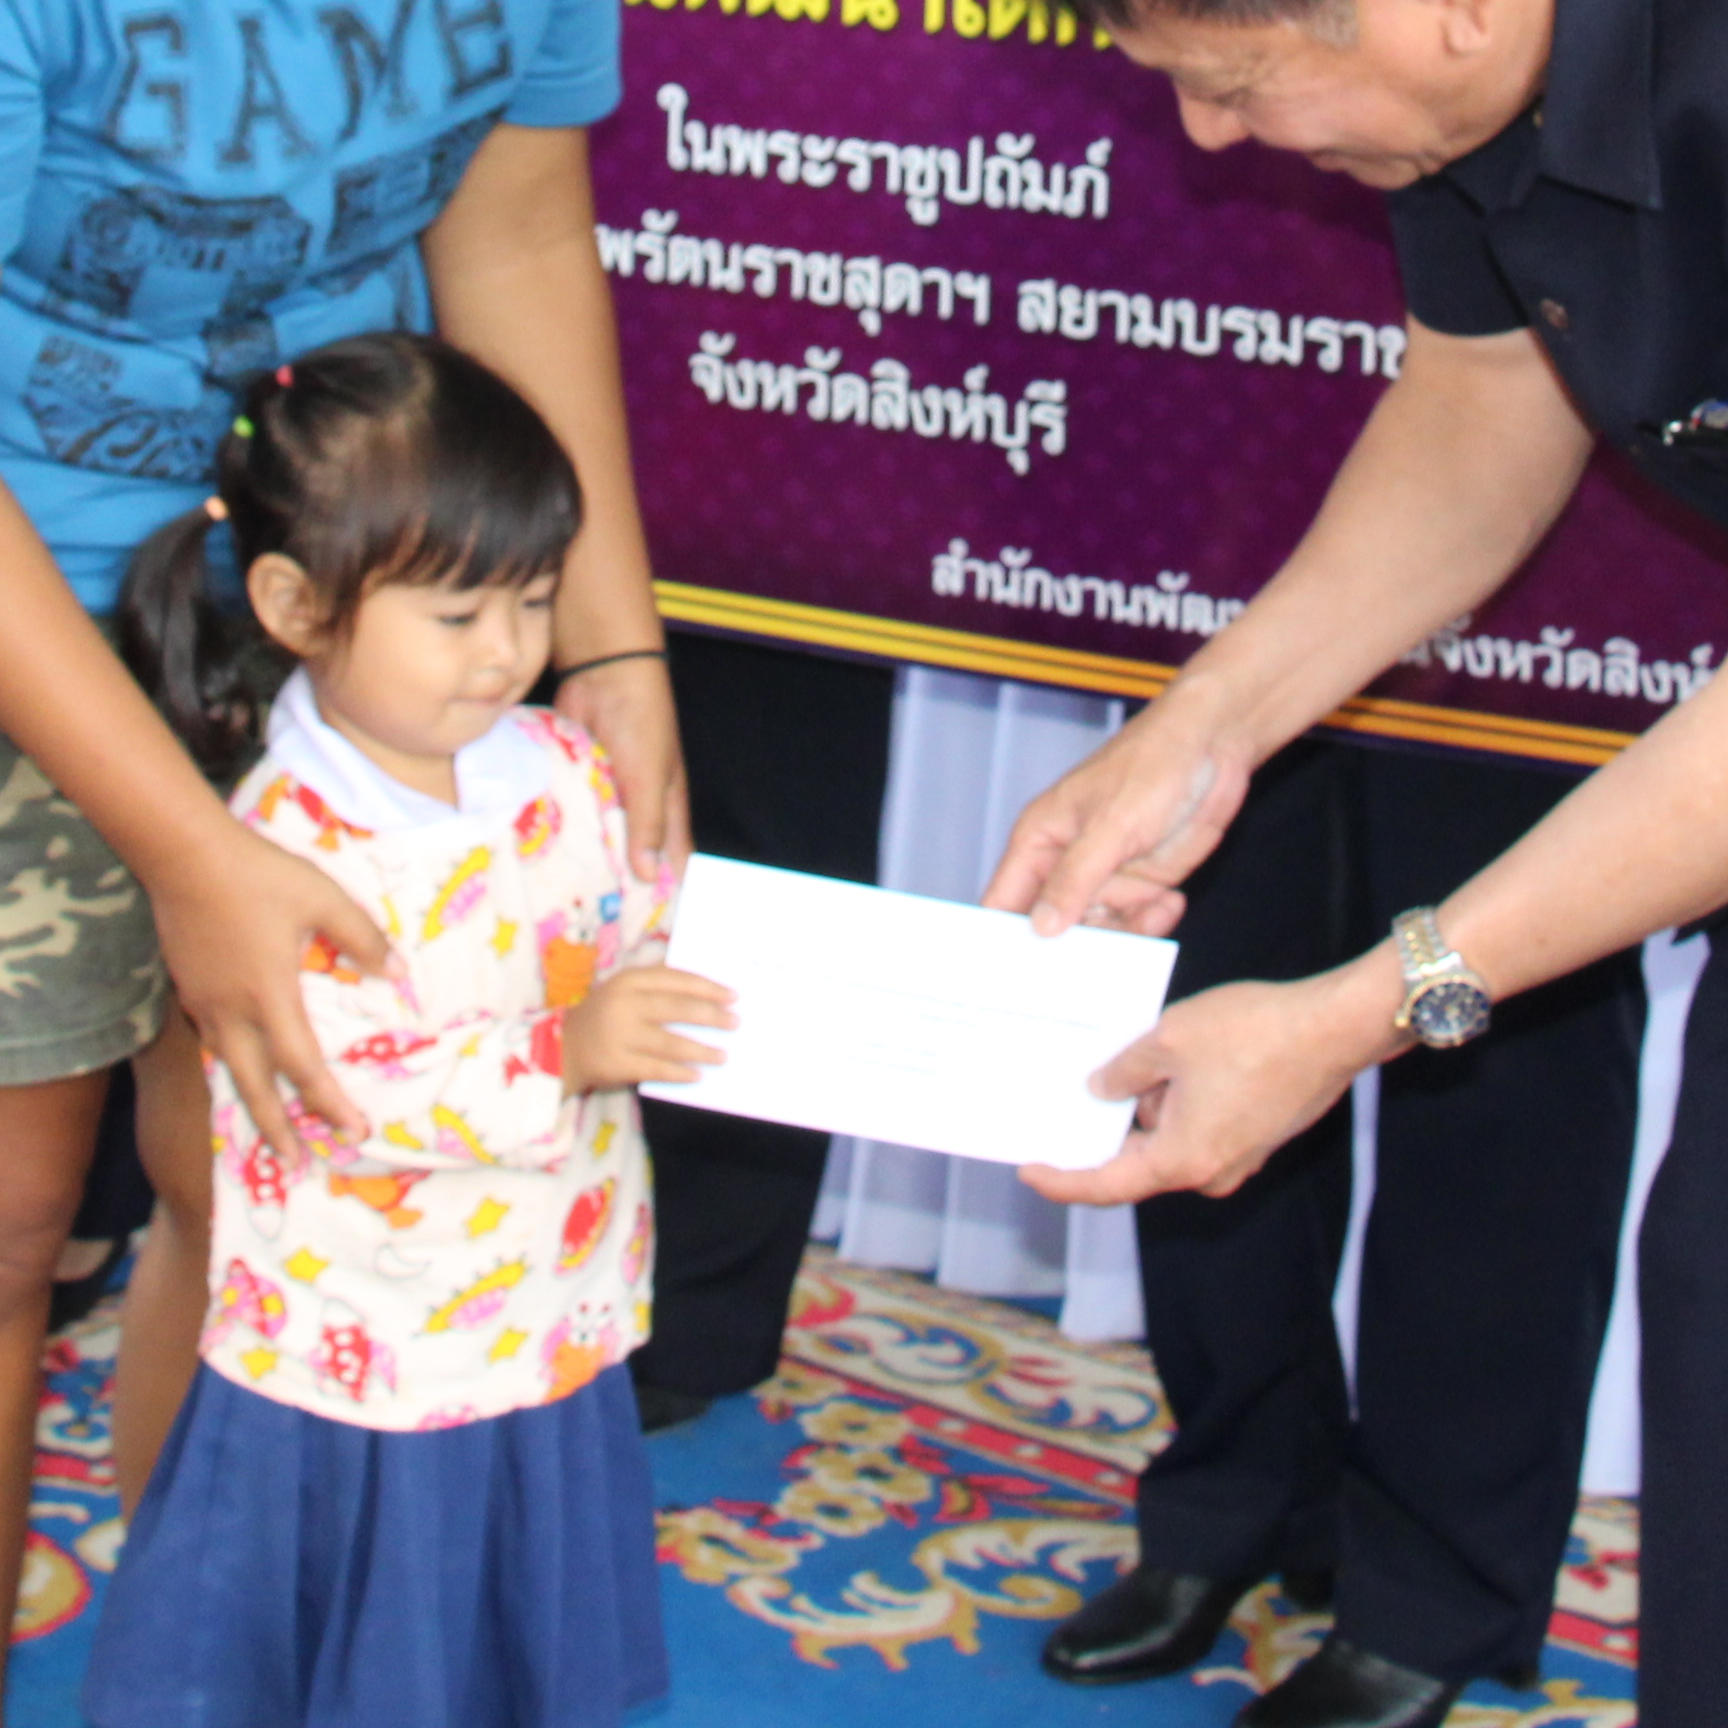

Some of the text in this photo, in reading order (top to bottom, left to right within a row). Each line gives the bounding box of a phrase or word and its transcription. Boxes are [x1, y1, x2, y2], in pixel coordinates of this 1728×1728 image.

[656, 81, 1112, 226] ในพระราชูปถัมภ์
[688, 330, 1068, 474] จังหวัดสิงห์บุรี
